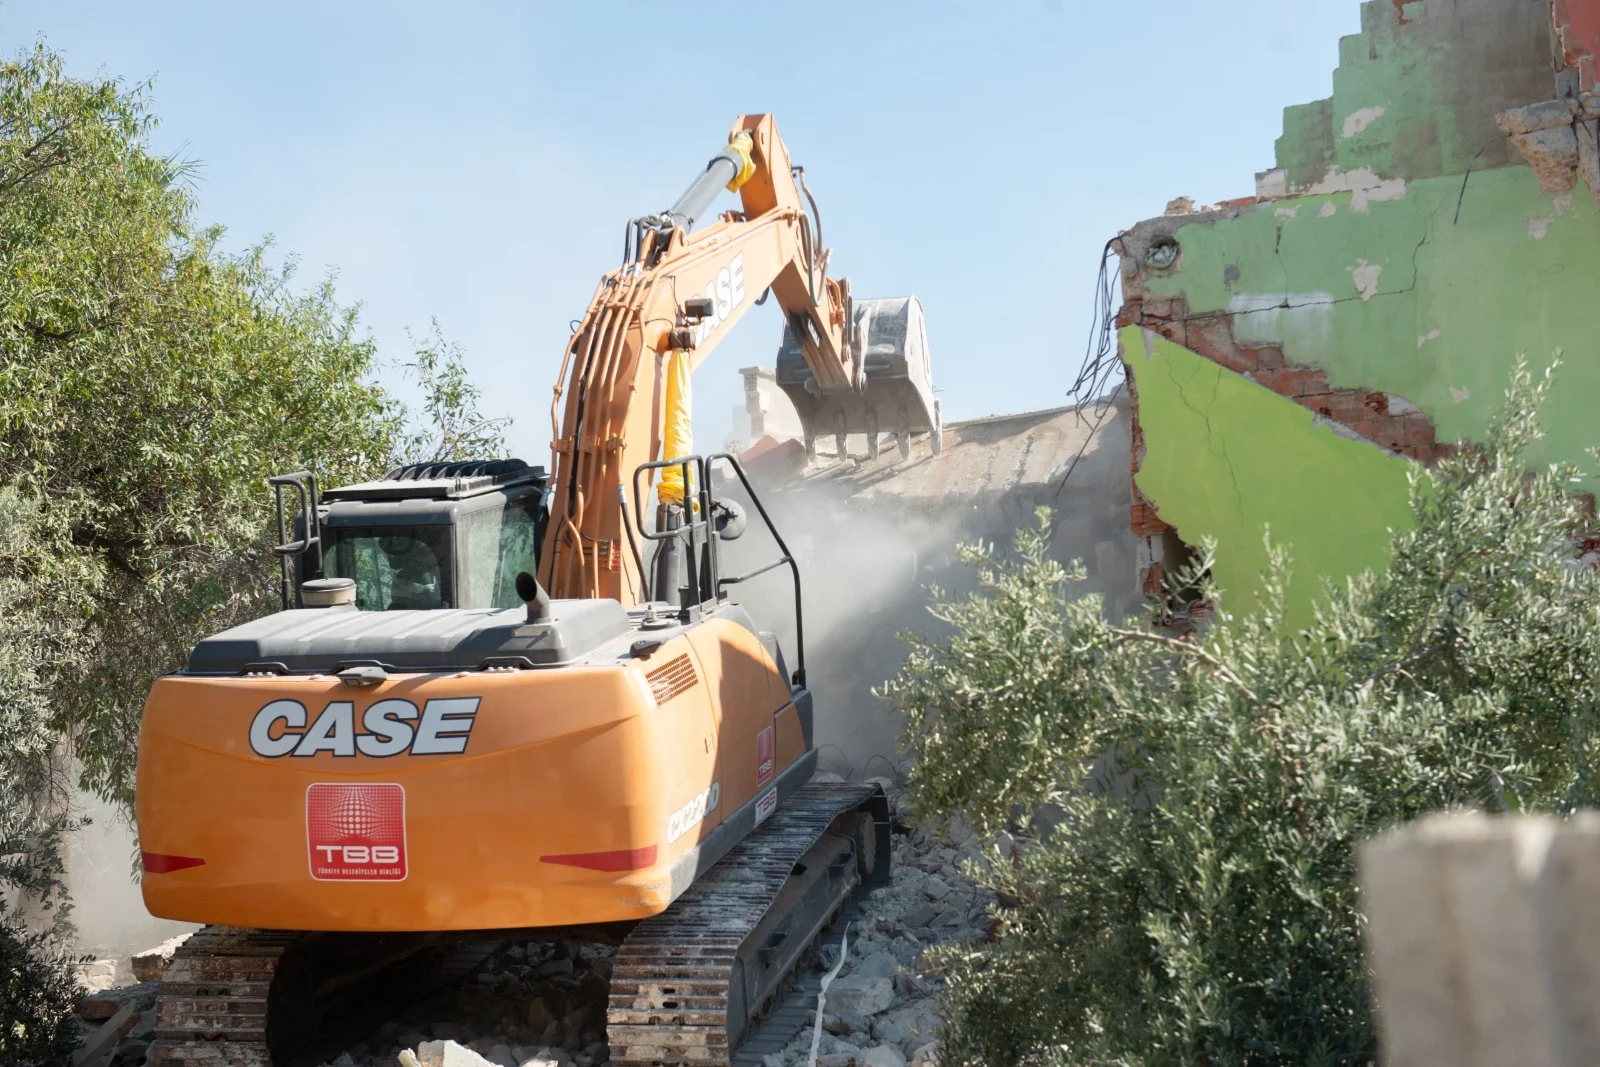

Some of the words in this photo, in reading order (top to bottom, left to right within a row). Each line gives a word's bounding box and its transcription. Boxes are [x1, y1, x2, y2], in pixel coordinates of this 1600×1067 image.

[249, 696, 482, 758] CASE
[757, 791, 776, 815] TBB
[316, 845, 399, 863] TBB
